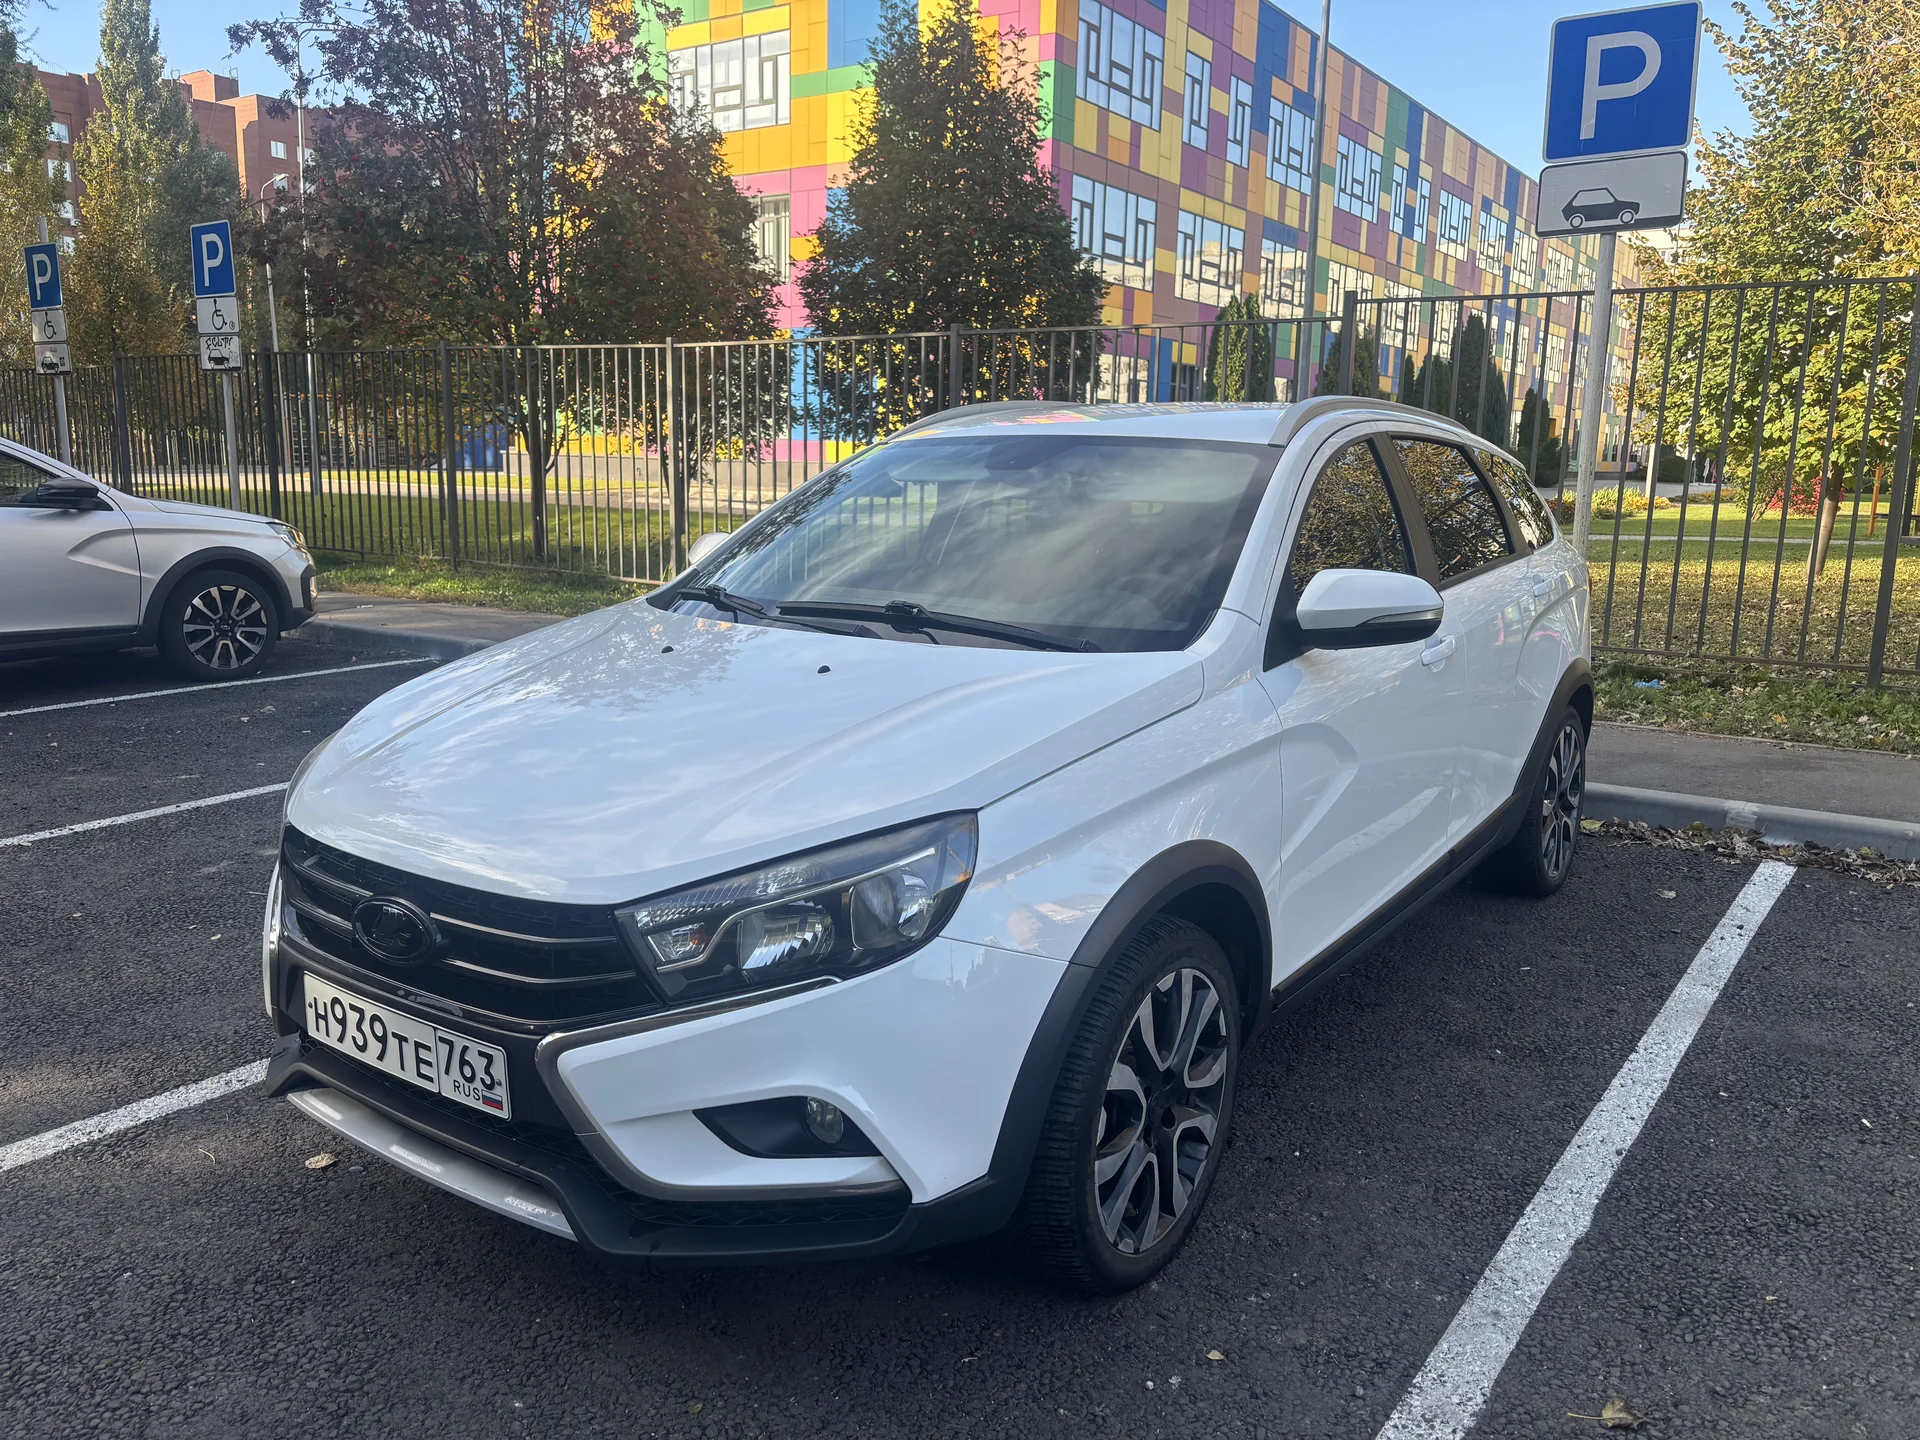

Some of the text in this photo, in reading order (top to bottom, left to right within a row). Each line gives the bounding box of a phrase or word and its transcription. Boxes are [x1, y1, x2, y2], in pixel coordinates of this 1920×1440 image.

[1579, 30, 1662, 140] P
[32, 253, 52, 301] P
[200, 232, 224, 287] P
[438, 1035, 496, 1091] 763
[453, 1079, 481, 1101] RUS
